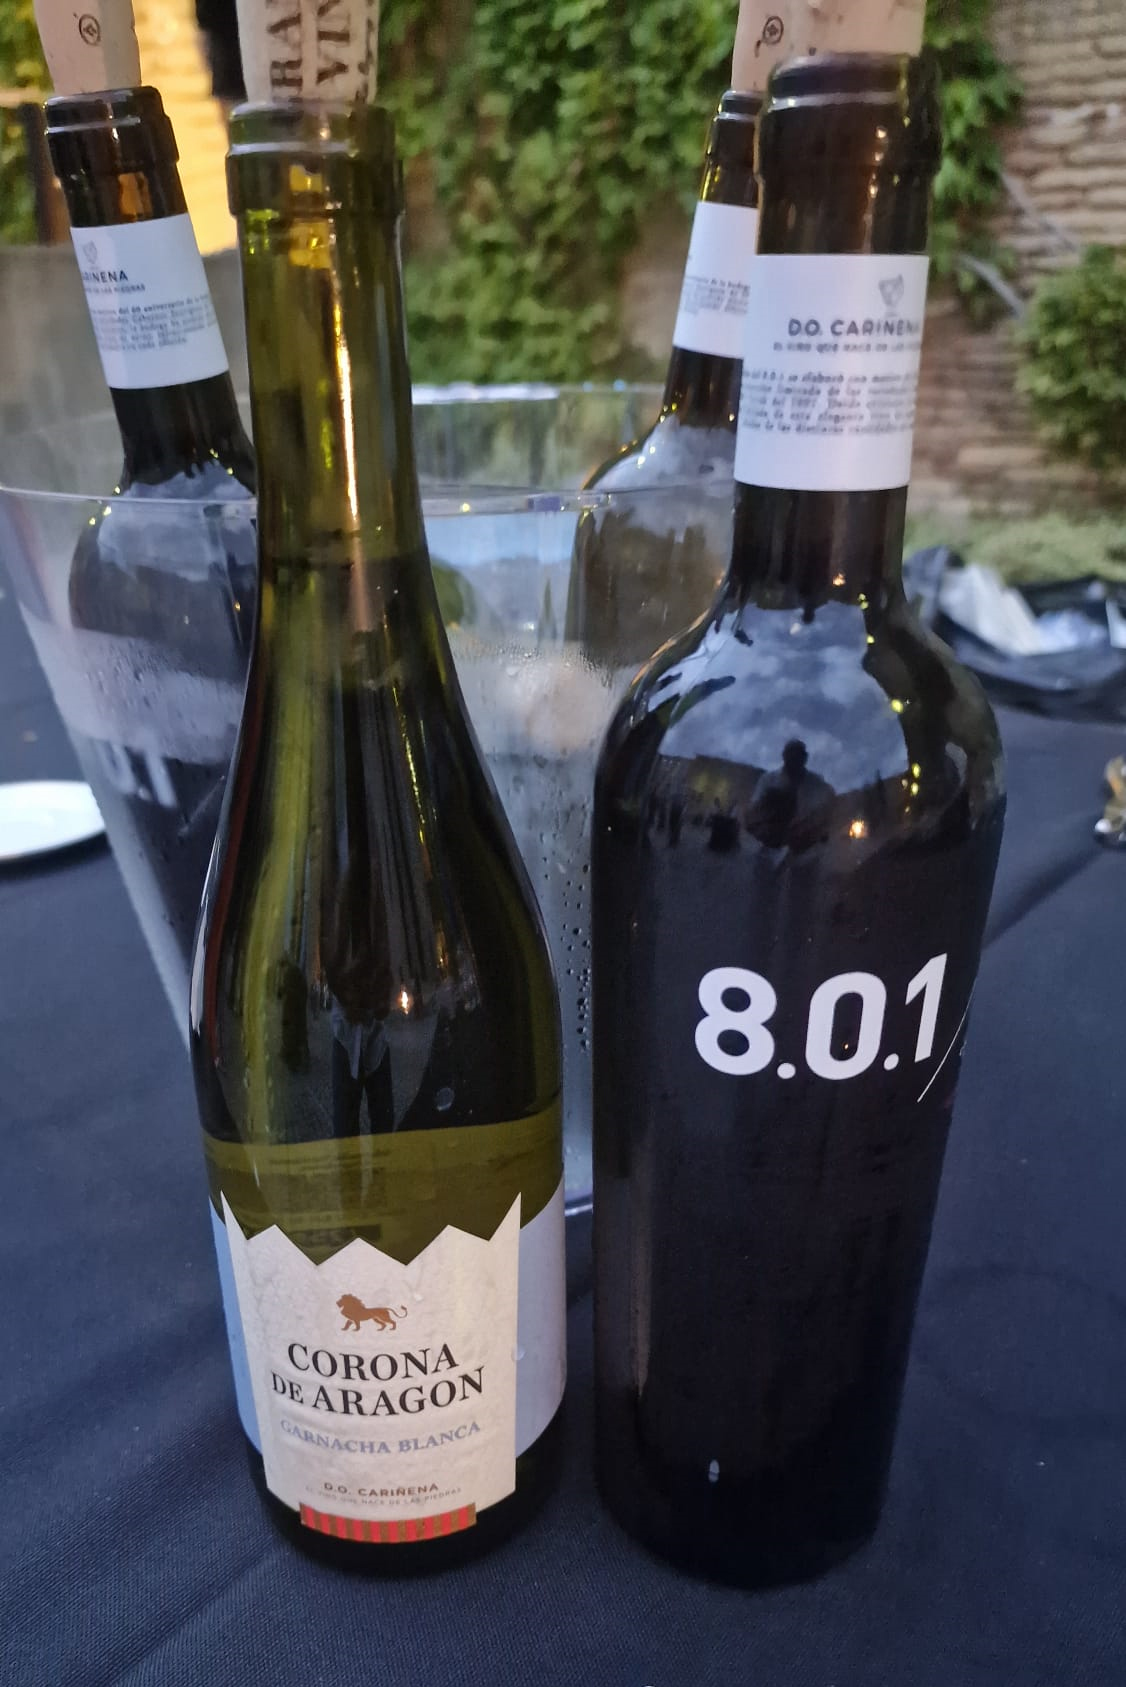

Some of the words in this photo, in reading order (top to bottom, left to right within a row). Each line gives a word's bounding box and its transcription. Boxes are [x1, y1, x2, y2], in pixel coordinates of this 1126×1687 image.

[694, 952, 948, 1081] 8.0.1
[287, 1342, 460, 1382] CORONA
[271, 1369, 305, 1405] DE
[311, 1364, 486, 1417] ARAGON
[279, 1419, 392, 1455] GARNACHA
[398, 1420, 482, 1454] BLANCA
[324, 1482, 352, 1495] D.O.
[357, 1482, 440, 1498] CARIÑENA
